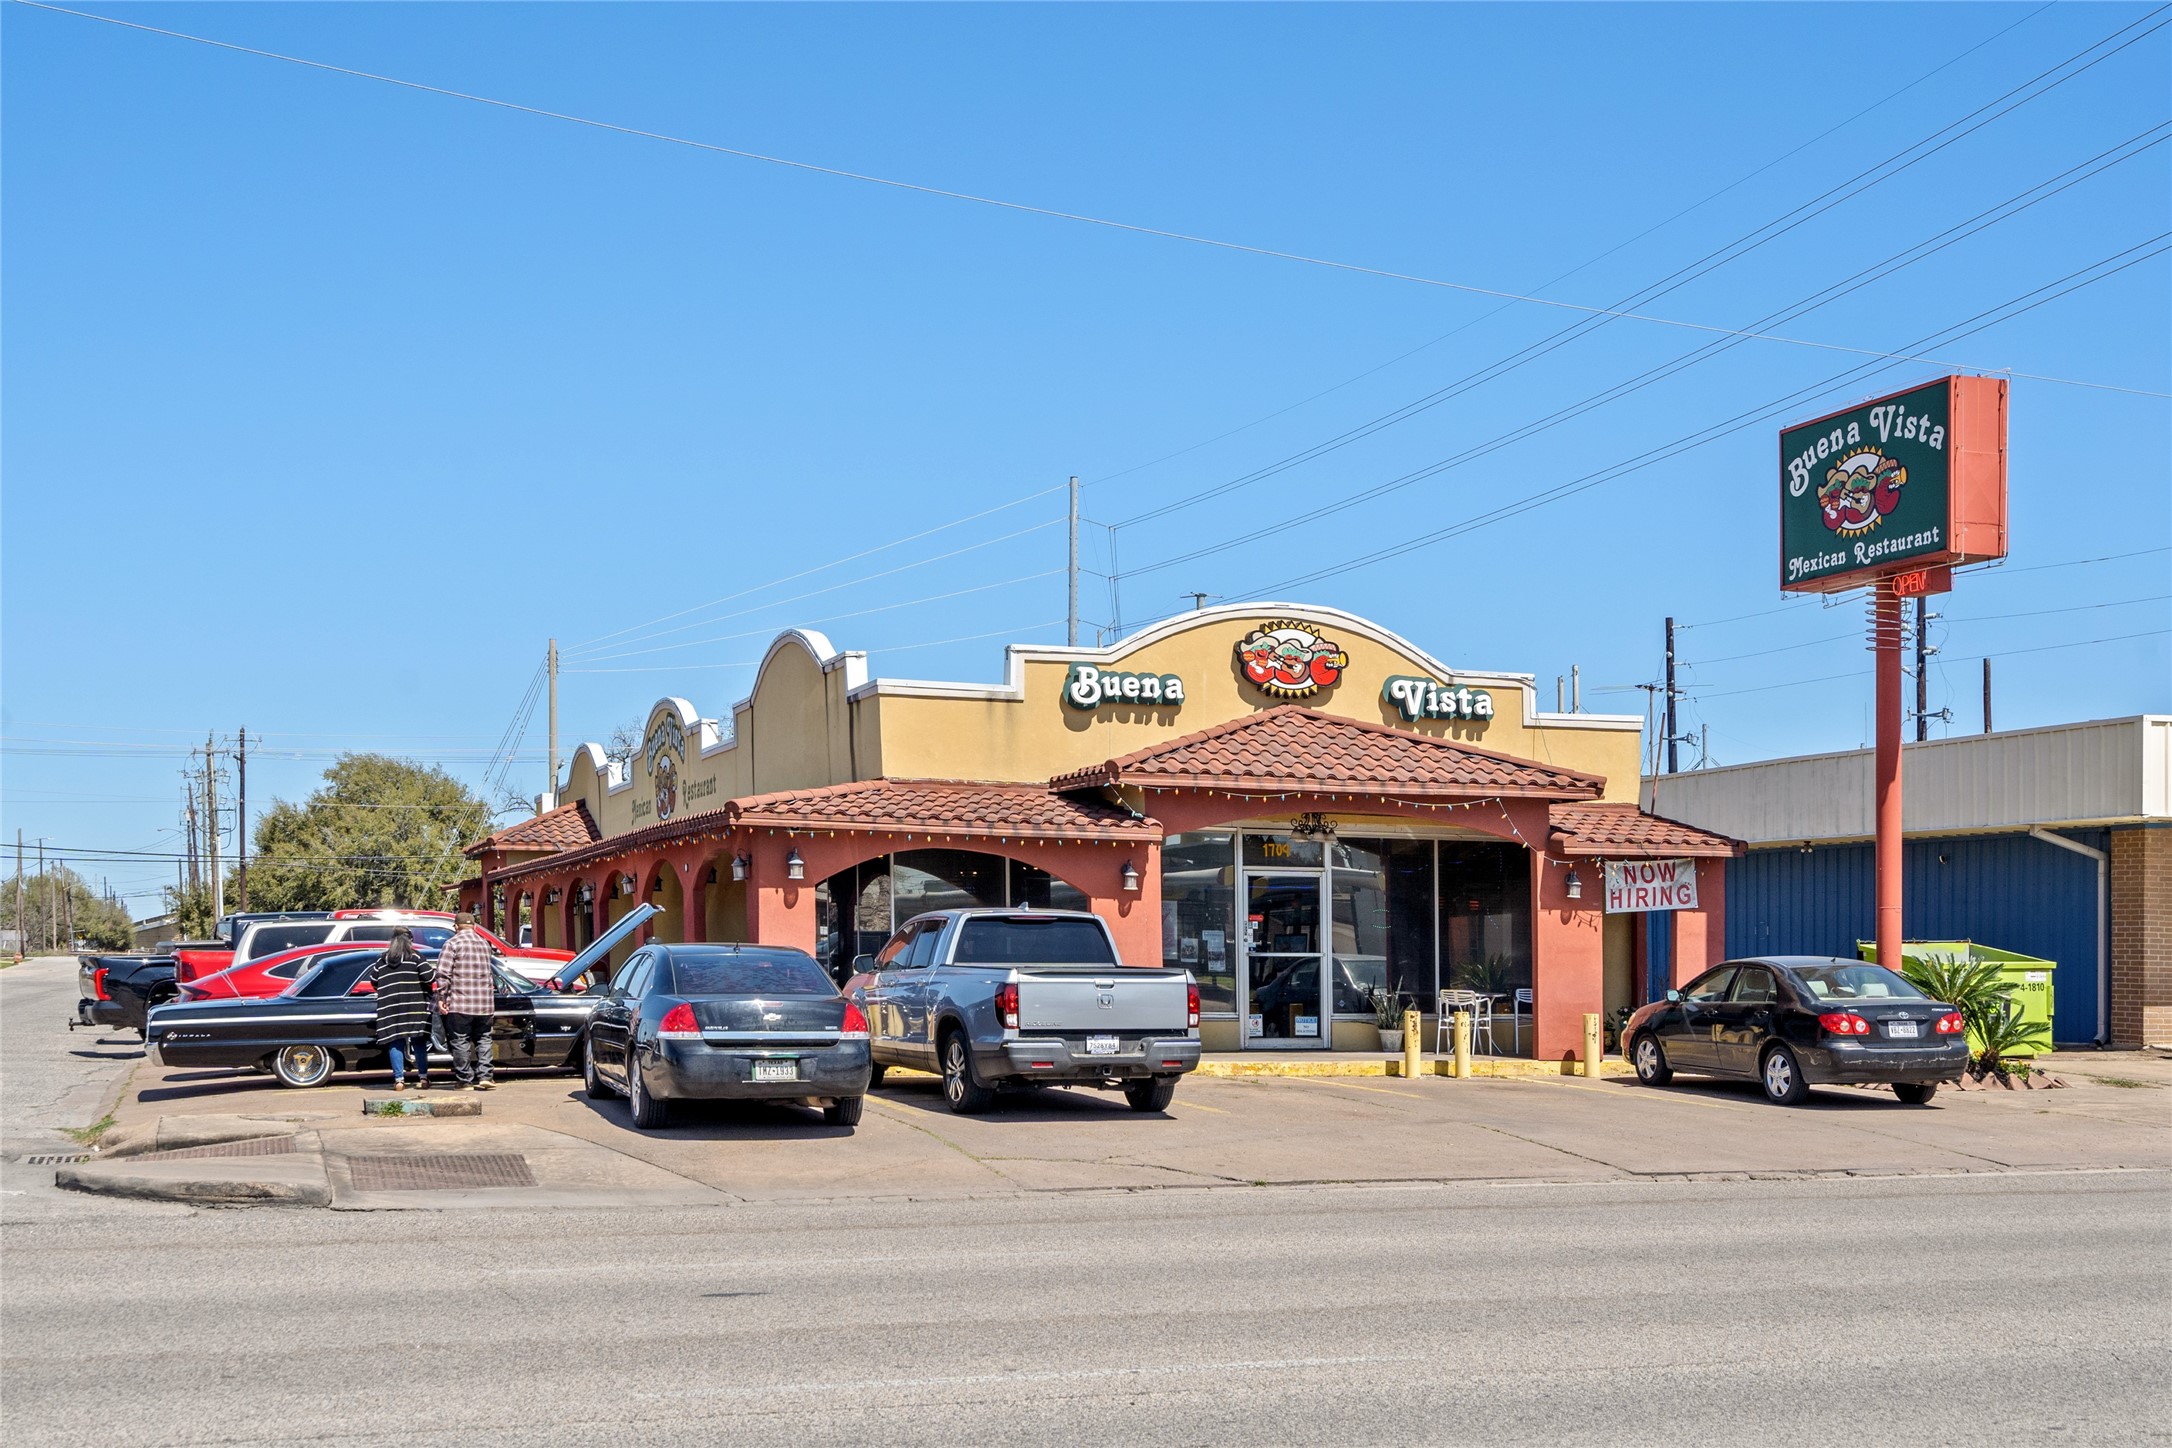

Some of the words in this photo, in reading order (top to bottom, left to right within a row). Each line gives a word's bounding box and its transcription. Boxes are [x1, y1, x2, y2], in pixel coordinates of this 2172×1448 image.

[1788, 421, 1860, 497] Buena
[1870, 405, 1945, 450] Vista
[1789, 551, 1846, 581] Mexican
[1854, 526, 1940, 564] Restaurant
[1893, 571, 1926, 596] OPEN
[1070, 666, 1184, 704] Buena
[1391, 679, 1494, 716] Vista
[1263, 843, 1290, 858] 1709
[1623, 862, 1676, 885] NOW
[1610, 883, 1692, 909] HIRING
